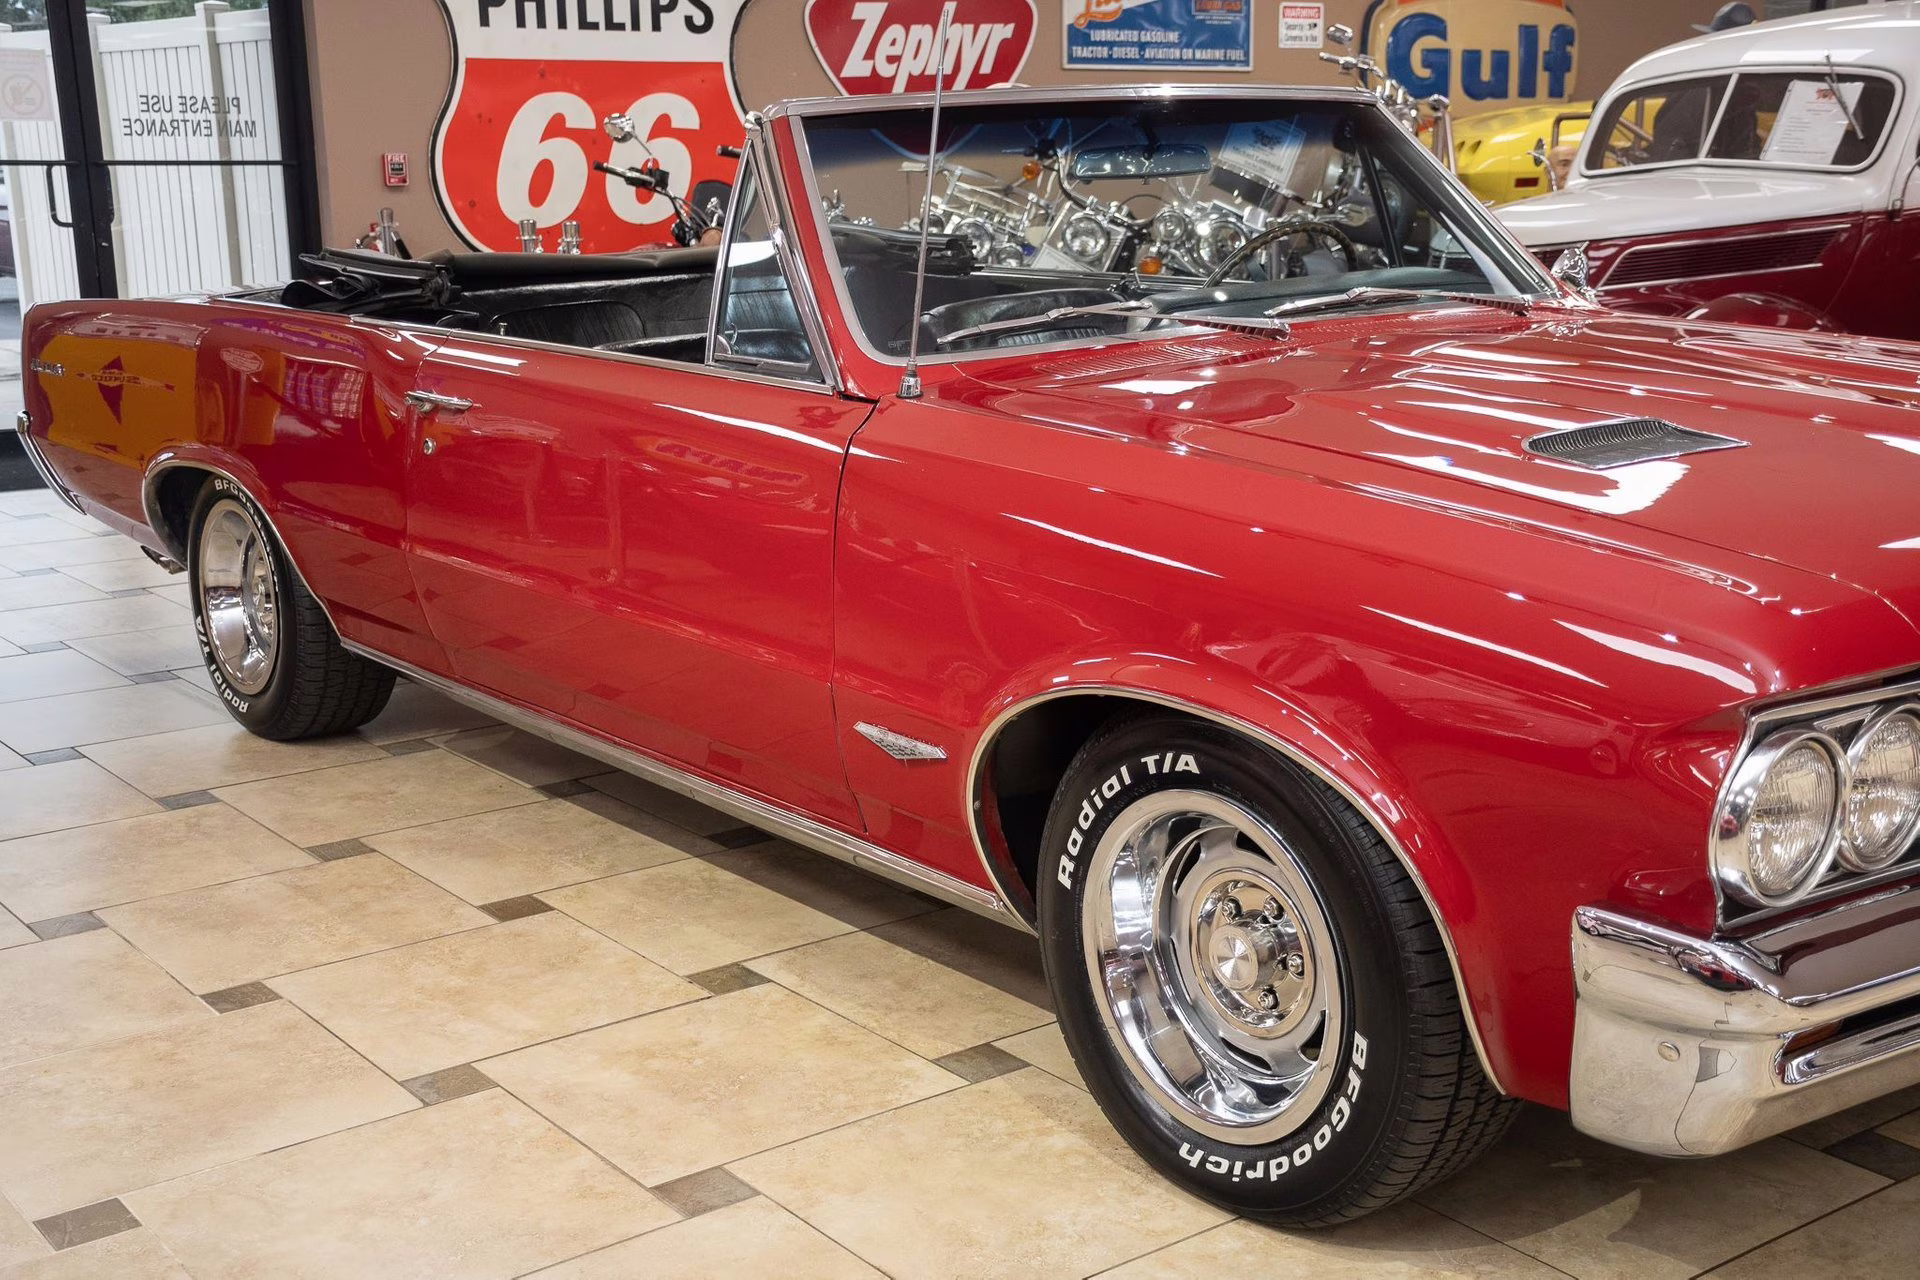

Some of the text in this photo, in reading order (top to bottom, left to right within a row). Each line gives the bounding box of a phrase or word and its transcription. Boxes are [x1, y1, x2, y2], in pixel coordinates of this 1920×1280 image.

[839, 1, 1016, 95] Zephyr
[1072, 46, 1109, 59] TRACTOR
[1112, 47, 1140, 59] DIESEL
[1144, 47, 1181, 60] AVIATION
[1182, 48, 1194, 60] OR
[1195, 48, 1225, 60] MARINE
[1090, 29, 1181, 43] LUBRICATED GASOLINE
[1386, 12, 1575, 101] Gulf
[495, 91, 701, 229] 66
[196, 615, 250, 713] Radial T/A
[1056, 765, 1133, 890] Radial
[1140, 752, 1201, 775] T/A
[1177, 1030, 1369, 1183] BFGoodrich
